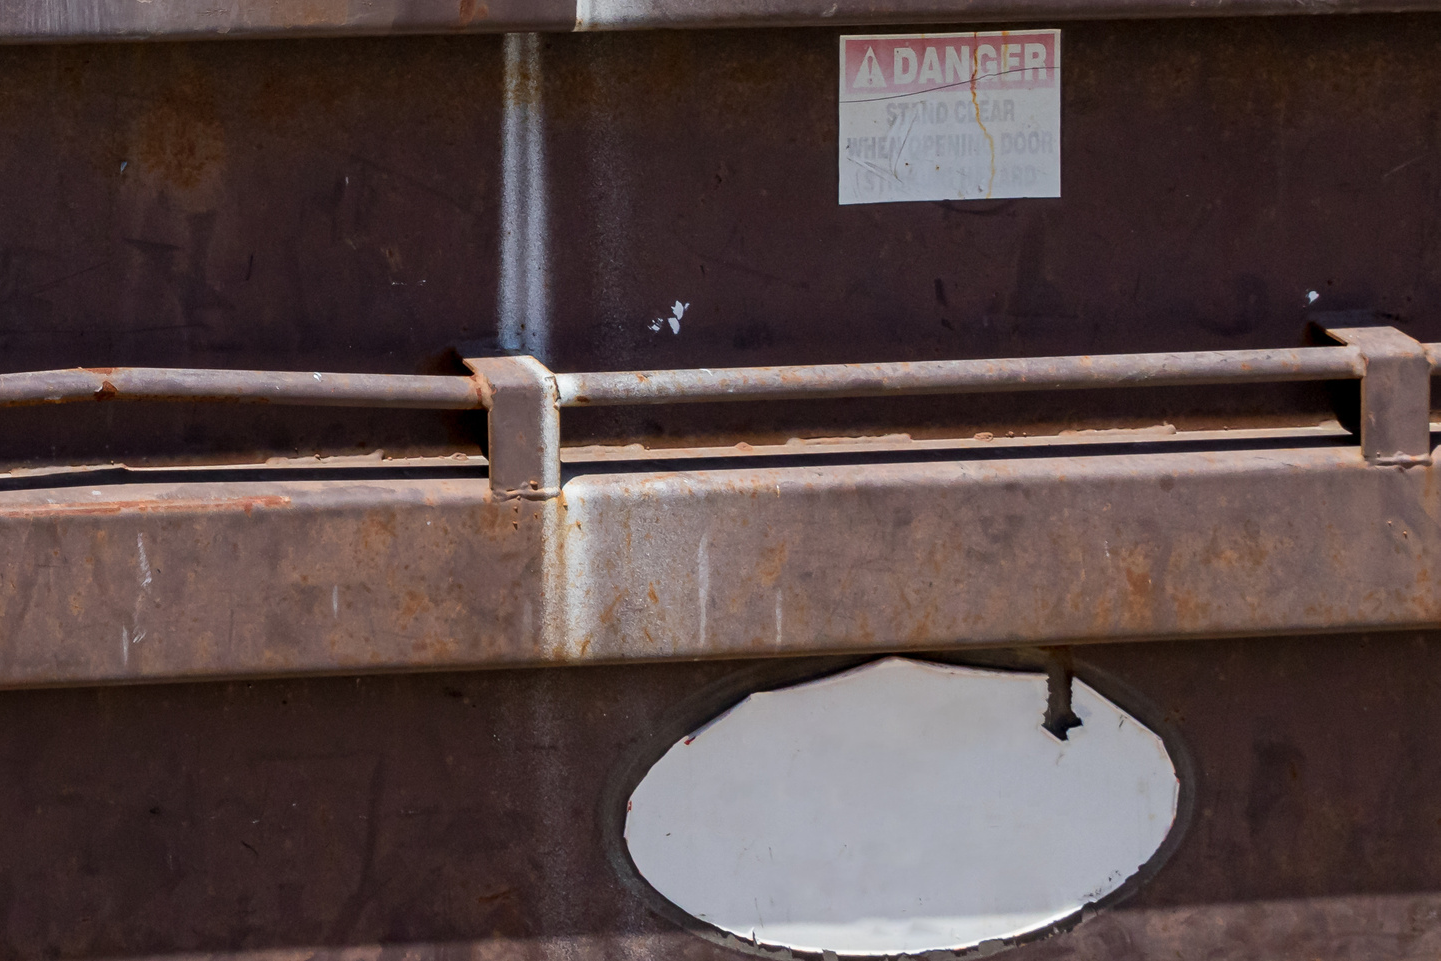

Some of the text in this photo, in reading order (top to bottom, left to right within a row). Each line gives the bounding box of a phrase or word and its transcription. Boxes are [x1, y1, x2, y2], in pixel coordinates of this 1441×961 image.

[894, 43, 1047, 85] DANGER
[886, 100, 1015, 126] STND CLEAR
[908, 133, 990, 157] OPENIN
[1000, 131, 1053, 155] DOOR
